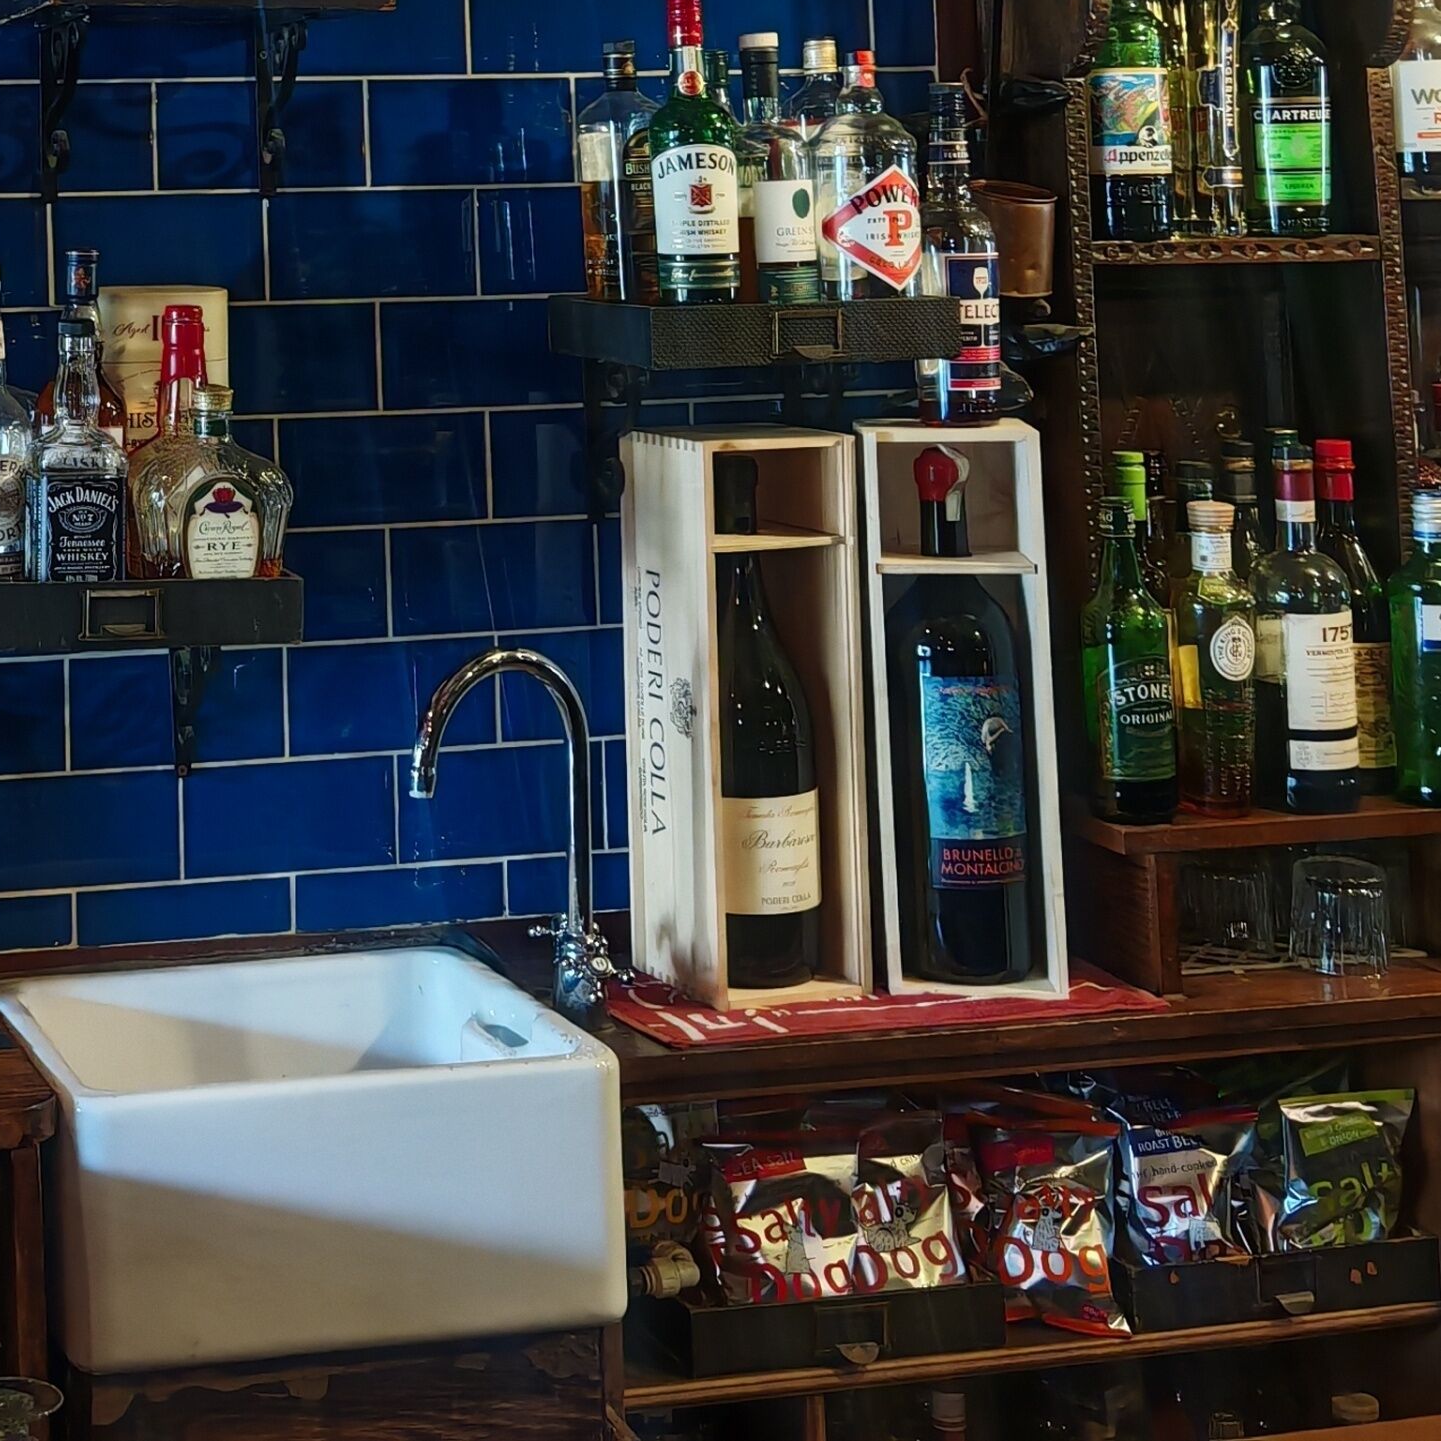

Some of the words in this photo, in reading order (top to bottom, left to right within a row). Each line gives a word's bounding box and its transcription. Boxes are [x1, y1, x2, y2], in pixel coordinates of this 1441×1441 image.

[1253, 108, 1331, 121] CARTREUE
[625, 162, 650, 175] BUSH
[658, 152, 735, 180] JAMESON
[850, 182, 920, 215] POWER
[960, 303, 999, 320] ELEC
[47, 489, 76, 514] JACK
[75, 486, 120, 514] DANIEL'S
[59, 536, 106, 548] Tennessee
[207, 541, 241, 551] RYE
[56, 552, 109, 561] WHISKEY
[645, 568, 663, 701] PODERI
[649, 717, 667, 835] COLLA
[942, 846, 1013, 861] BRUNELLO
[940, 860, 1025, 876] MONTALCINO
[1138, 1138, 1170, 1153] ROAST
[853, 1230, 957, 1292] Dog
[996, 1236, 1111, 1294] Dog
